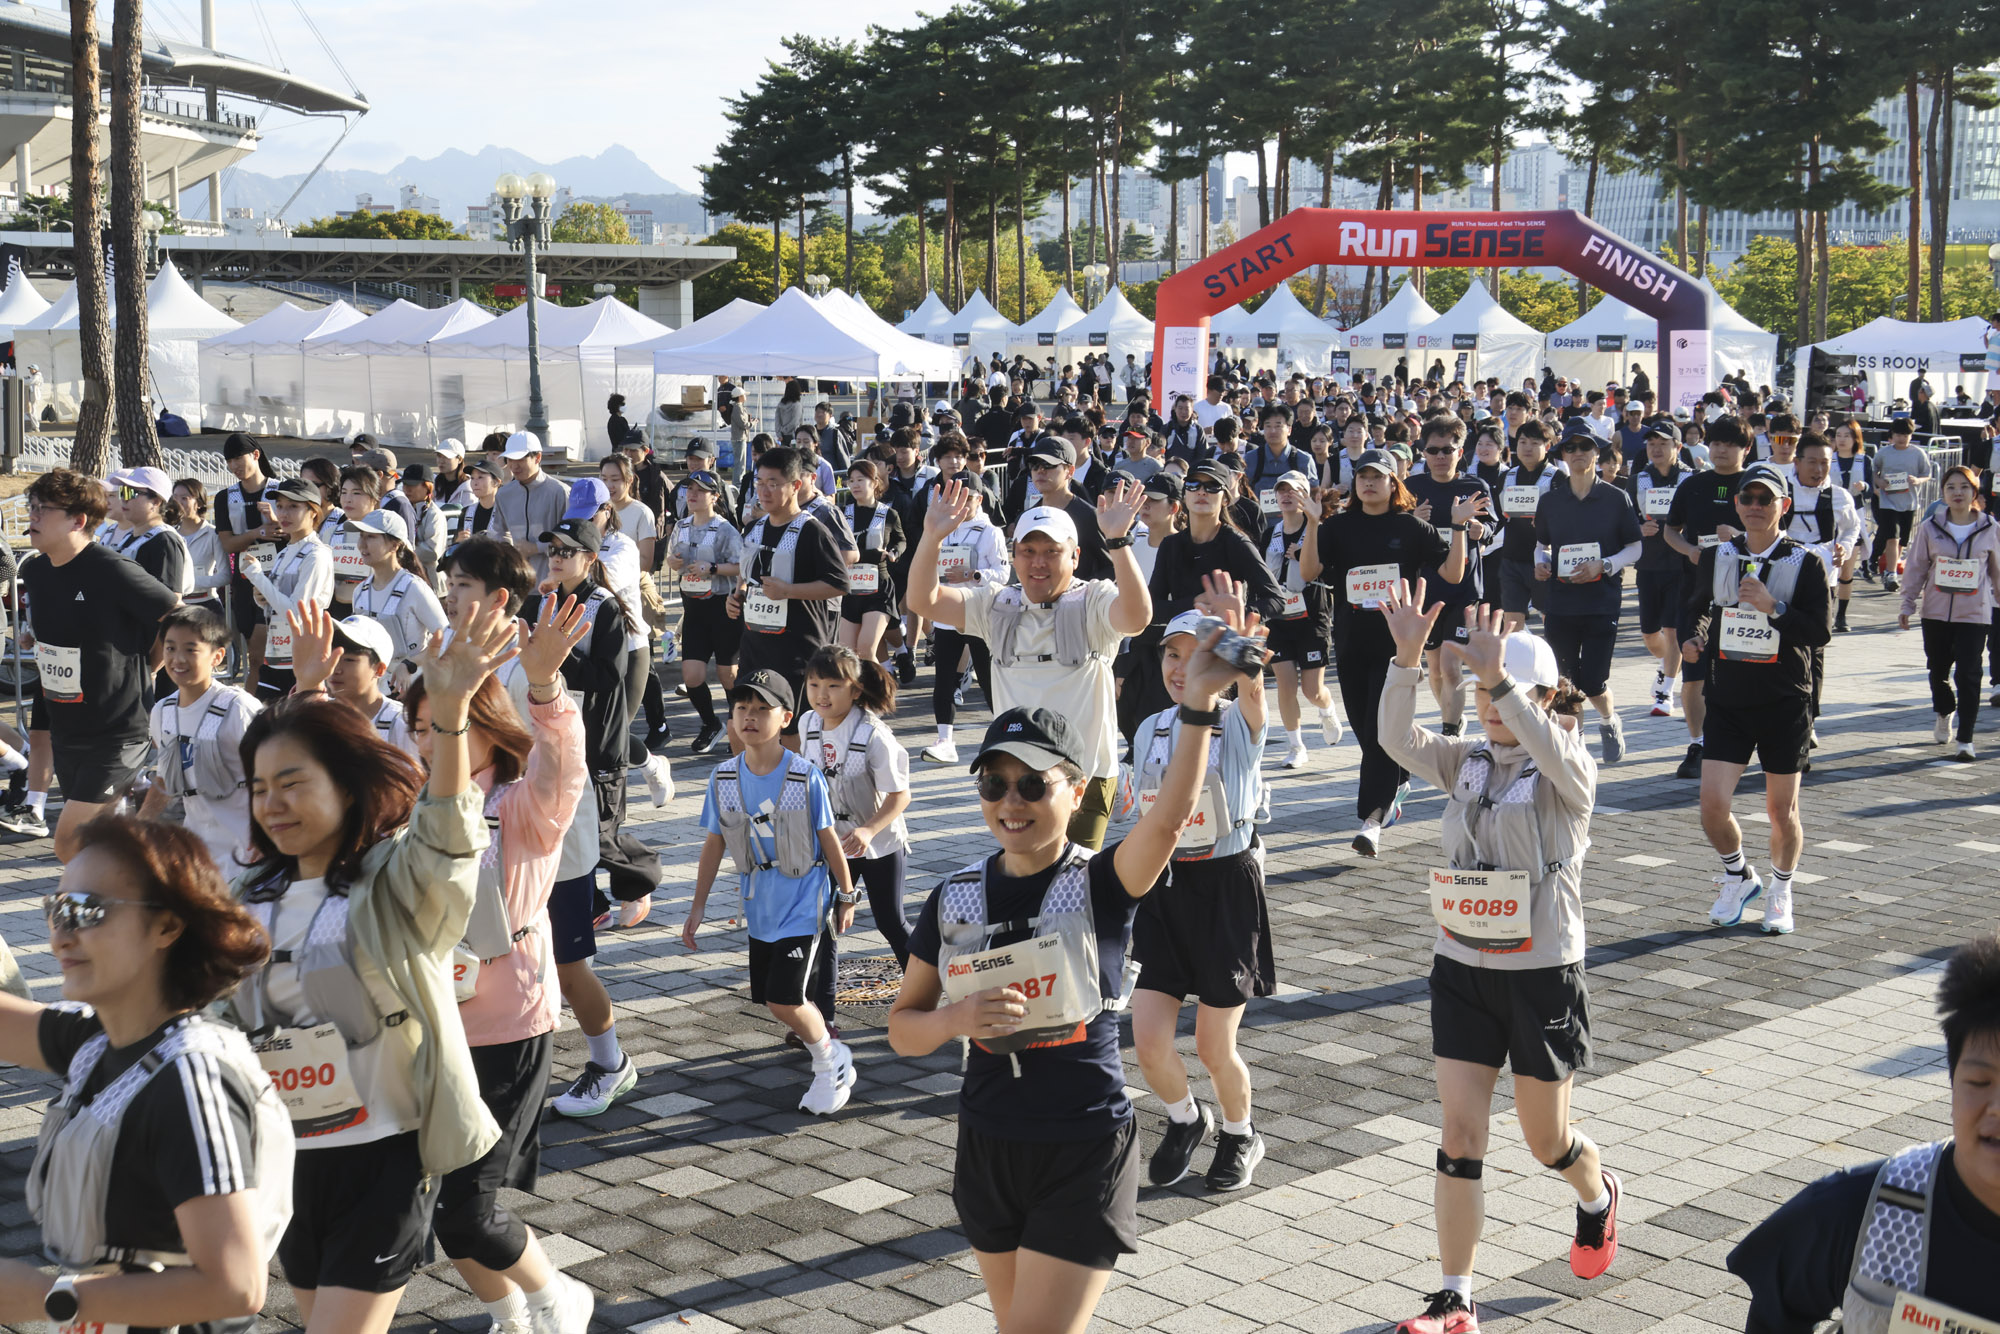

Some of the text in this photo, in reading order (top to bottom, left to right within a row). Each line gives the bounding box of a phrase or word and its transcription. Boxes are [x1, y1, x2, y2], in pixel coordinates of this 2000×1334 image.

[1203, 232, 1295, 299] START
[1580, 234, 1678, 303] FINISH
[1882, 356, 1930, 370] ROOM
[942, 558, 965, 567] 6191
[852, 573, 875, 582] 6438
[1948, 569, 1974, 579] 6279
[1353, 580, 1395, 592] W 6187
[754, 603, 781, 615] 5181
[1727, 626, 1773, 640] M 5224
[46, 663, 74, 679] 5100
[1442, 898, 1518, 917] W 6089
[1038, 938, 1058, 950] 5km
[268, 1062, 336, 1092] 6090
